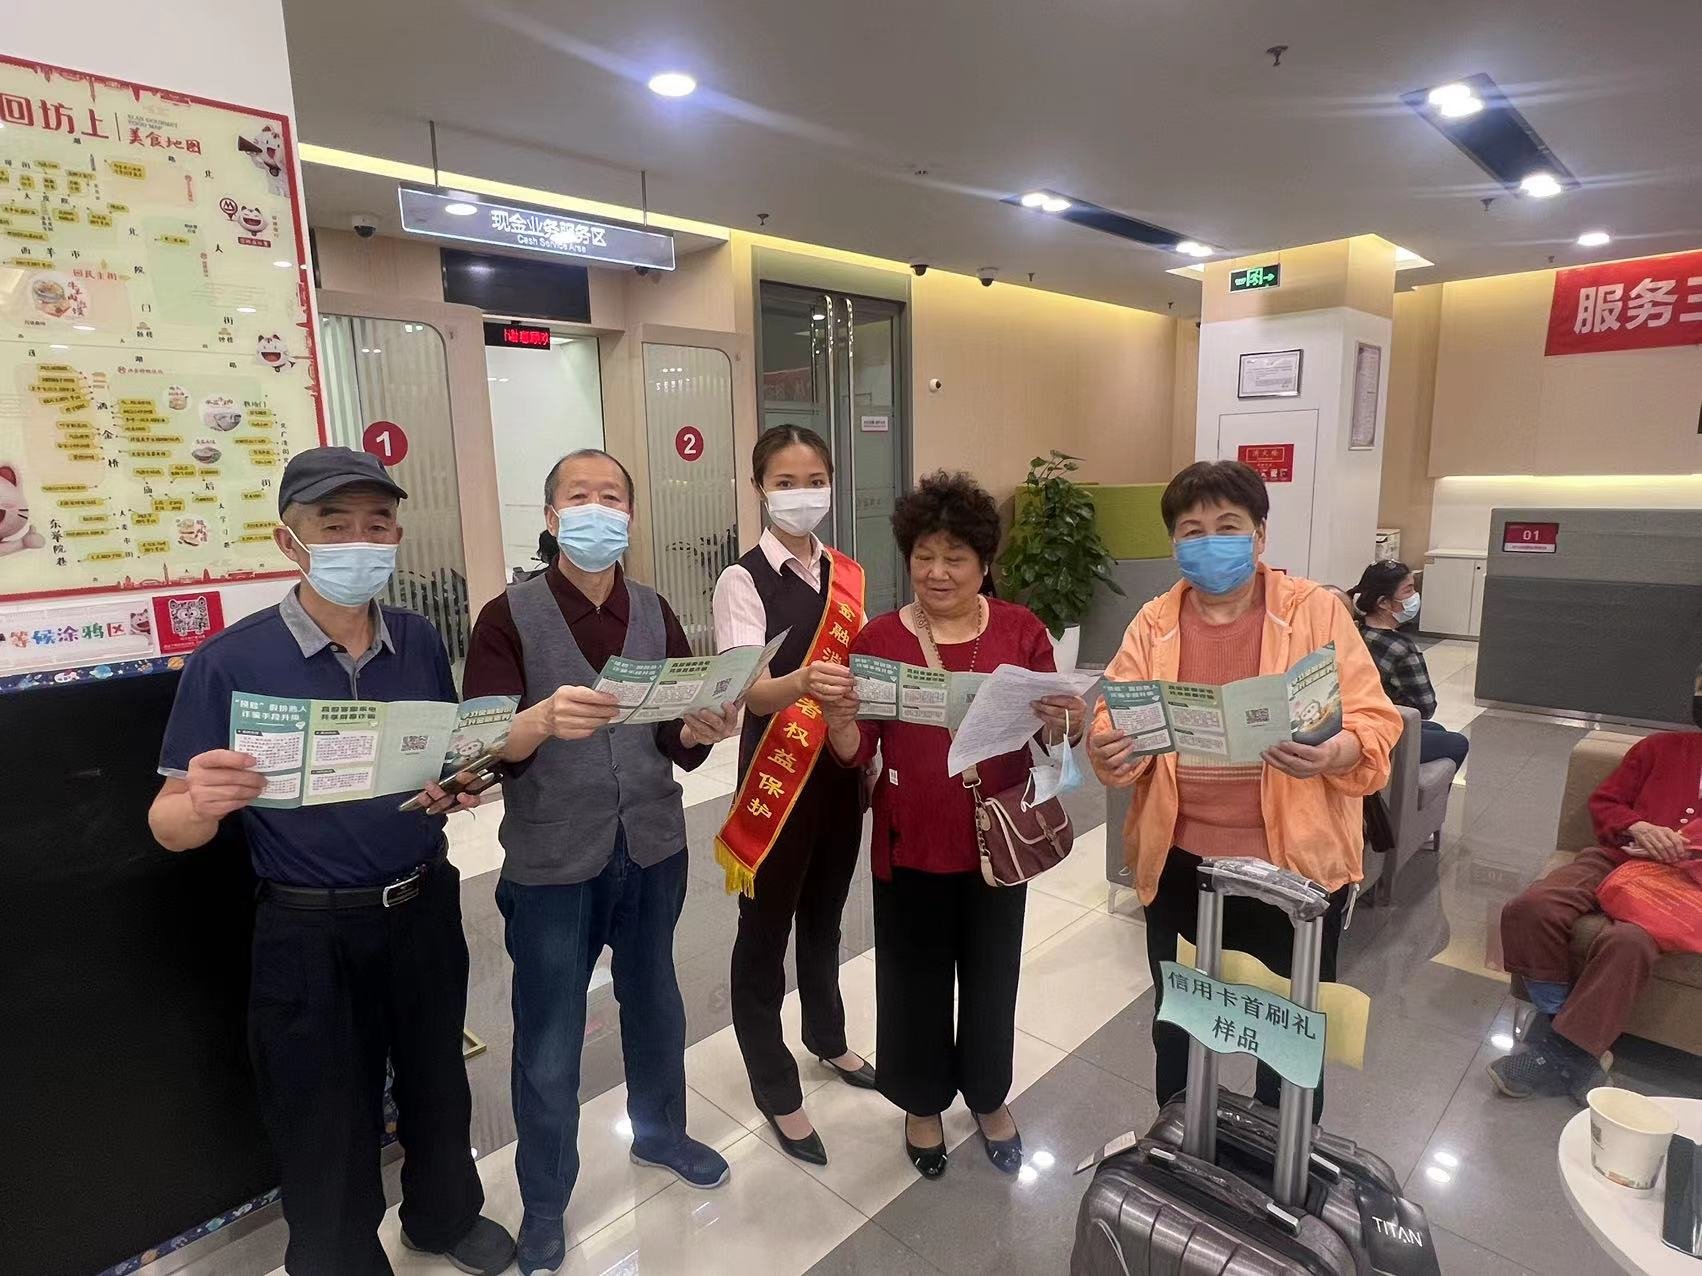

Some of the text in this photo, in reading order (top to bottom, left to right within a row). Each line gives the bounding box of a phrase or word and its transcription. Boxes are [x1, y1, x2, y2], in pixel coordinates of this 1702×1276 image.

[129, 127, 201, 155] 美食地图
[491, 209, 607, 247] 现金业务服务区
[517, 234, 538, 246] Cash
[569, 243, 587, 254] Area
[375, 431, 391, 457] 1
[683, 433, 697, 455] 2
[1523, 530, 1540, 541] 01
[746, 601, 857, 820] 金融消者权益保护
[1168, 970, 1317, 1041] 信用卡首刷礼
[1211, 1015, 1260, 1053] 样品
[1371, 1216, 1423, 1248] TITAN
